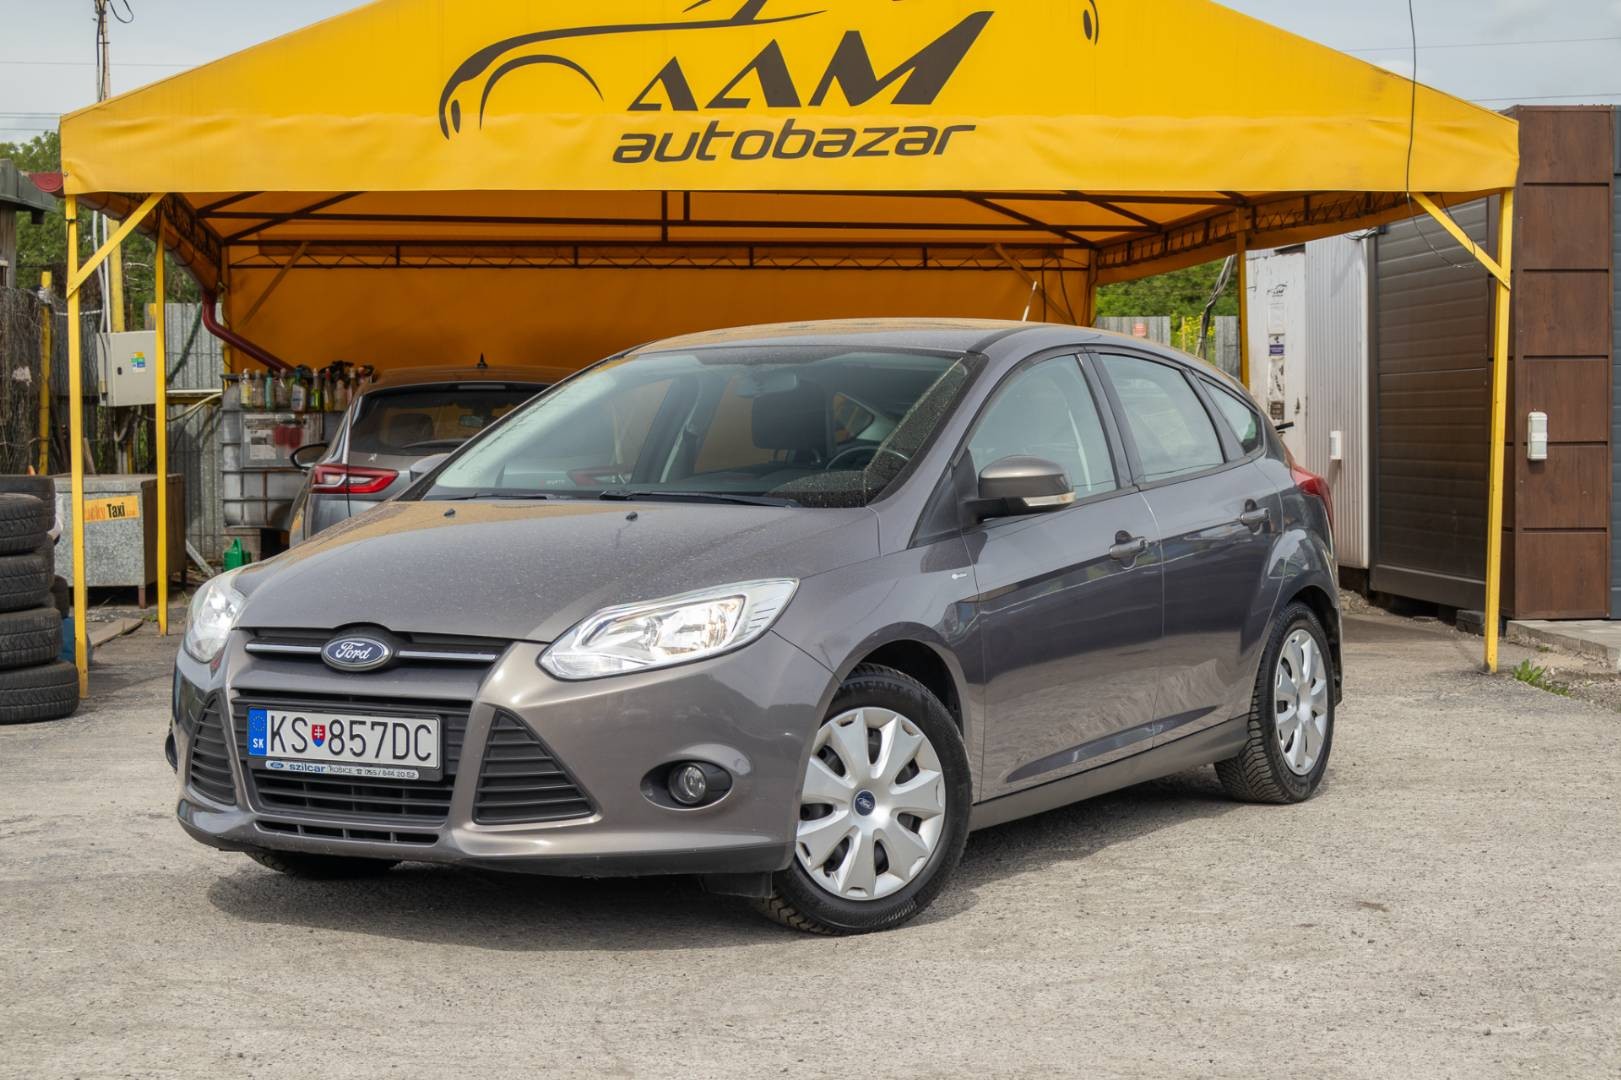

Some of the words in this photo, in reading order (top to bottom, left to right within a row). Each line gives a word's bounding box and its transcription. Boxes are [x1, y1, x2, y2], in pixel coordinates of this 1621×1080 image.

[626, 11, 995, 111] AAM
[612, 119, 977, 163] autobazar
[107, 502, 126, 518] Taxi
[335, 641, 373, 660] Ford
[252, 738, 265, 749] SK
[270, 715, 308, 754] KS
[328, 719, 433, 762] 857DC
[289, 762, 326, 773] szilcar
